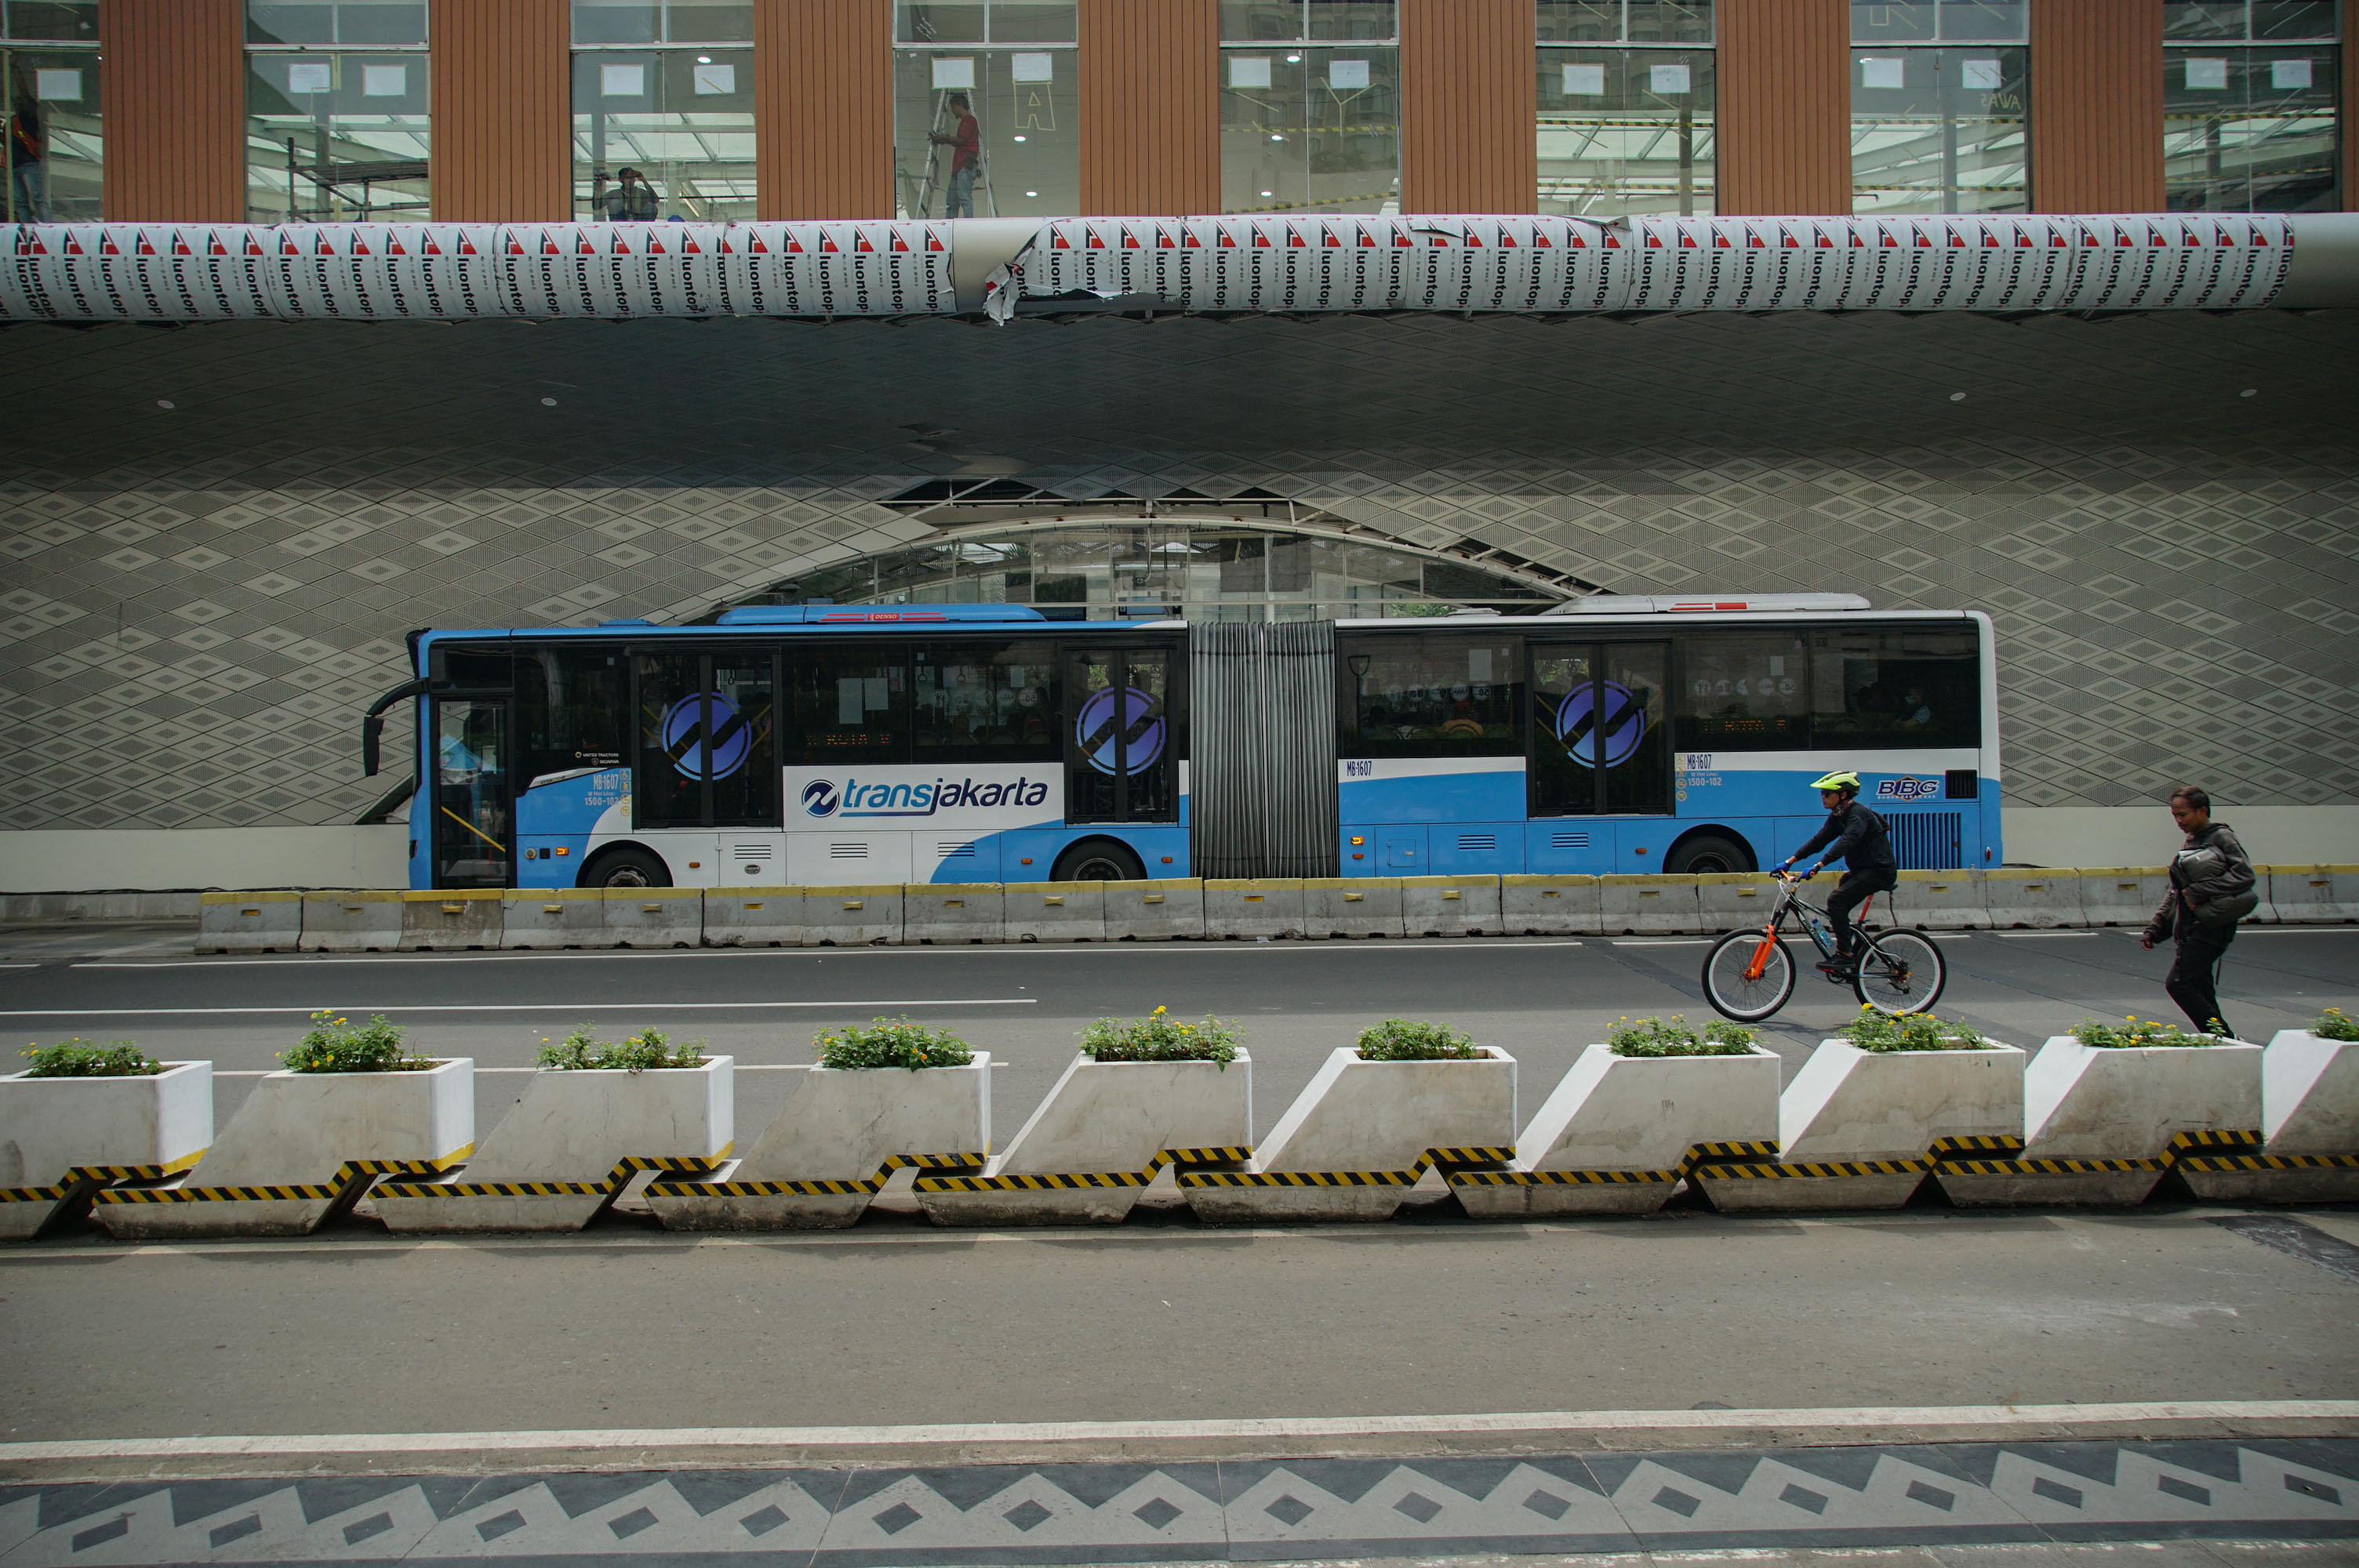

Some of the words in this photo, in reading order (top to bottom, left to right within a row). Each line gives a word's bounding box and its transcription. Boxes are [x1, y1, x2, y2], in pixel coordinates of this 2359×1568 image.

[1347, 760, 1372, 776] MB-1607
[1687, 753, 1712, 769] MB-1607
[593, 774, 619, 790] MB-1607
[1688, 777, 1722, 786] 1500-102
[1876, 779, 1939, 795] BBG
[584, 797, 619, 806] 1500-102
[840, 776, 1049, 817] transjakarta
